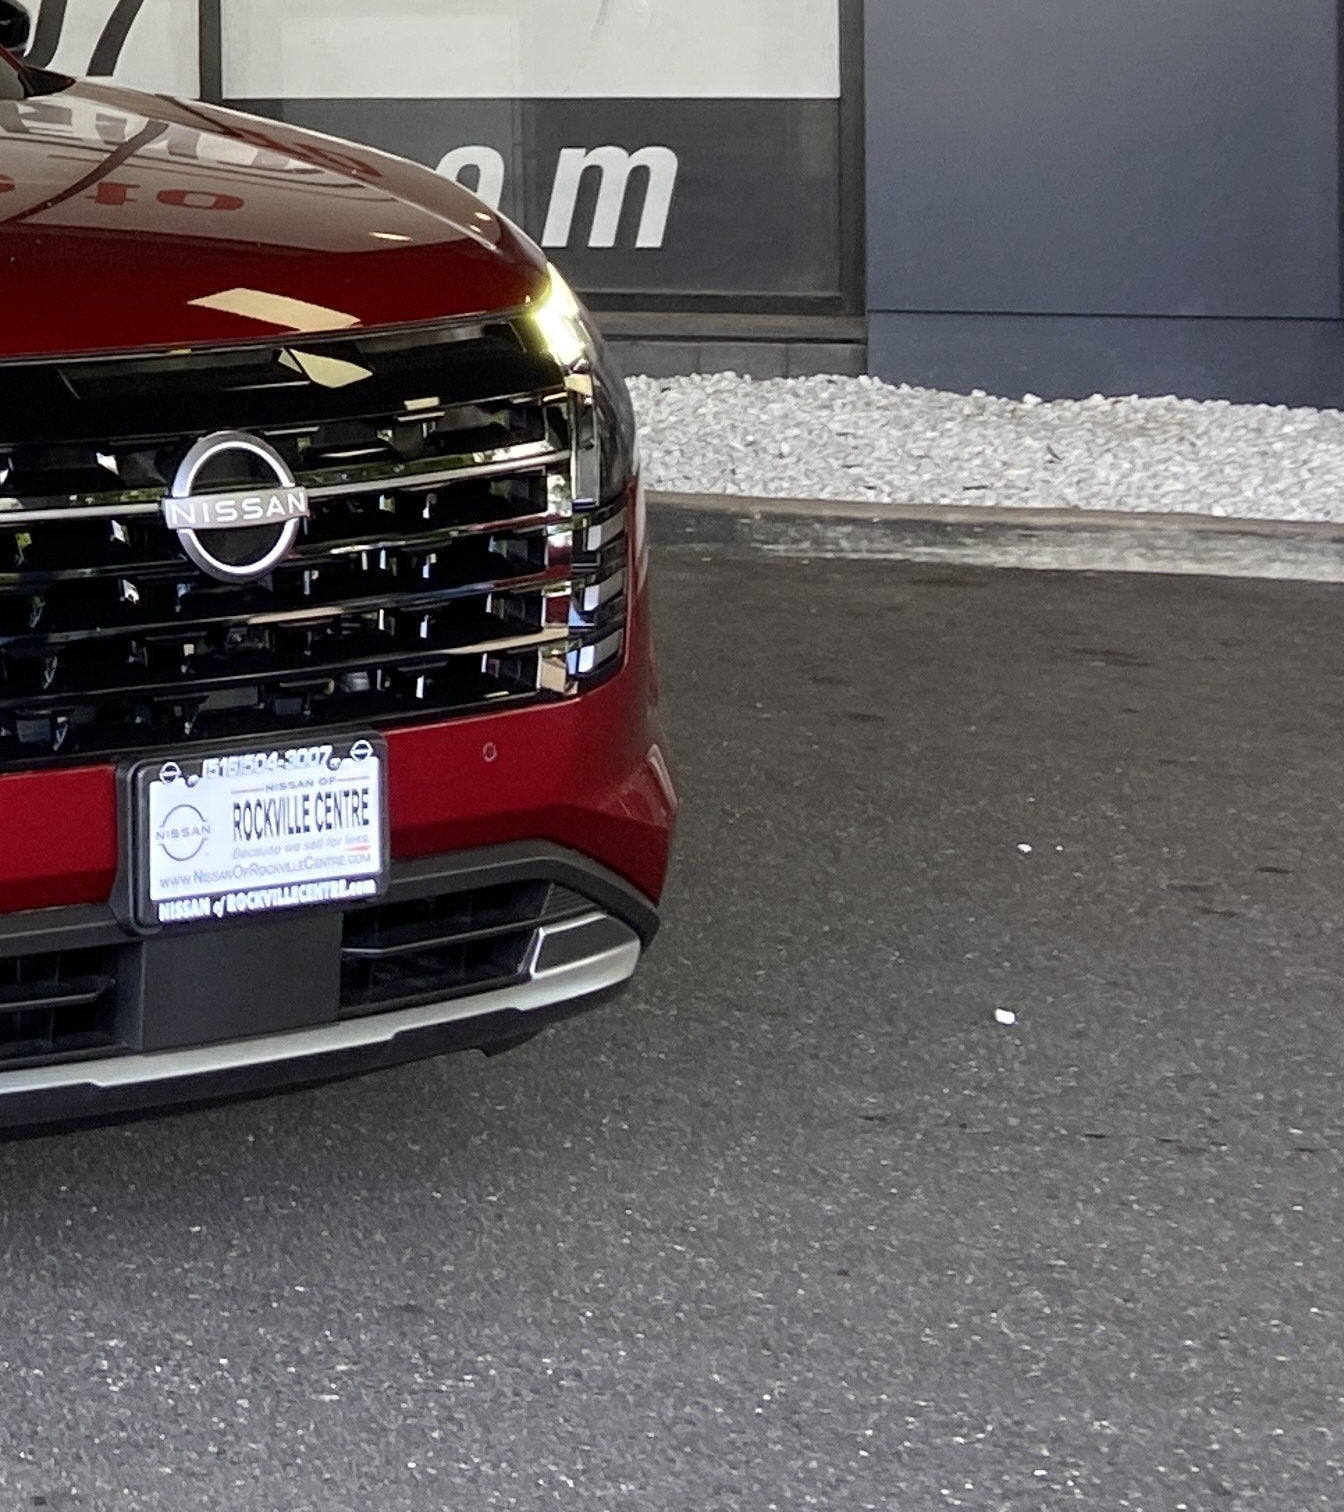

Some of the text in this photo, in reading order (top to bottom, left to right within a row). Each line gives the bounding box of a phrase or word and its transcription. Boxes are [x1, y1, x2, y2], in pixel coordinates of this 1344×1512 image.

[171, 492, 305, 525] NISSAN
[265, 776, 337, 792] NISSAN OF
[232, 788, 370, 842] ROCKVILLE CENTRE
[156, 825, 211, 841] NISSAN
[159, 896, 211, 922] NISSAN
[213, 895, 227, 919] of
